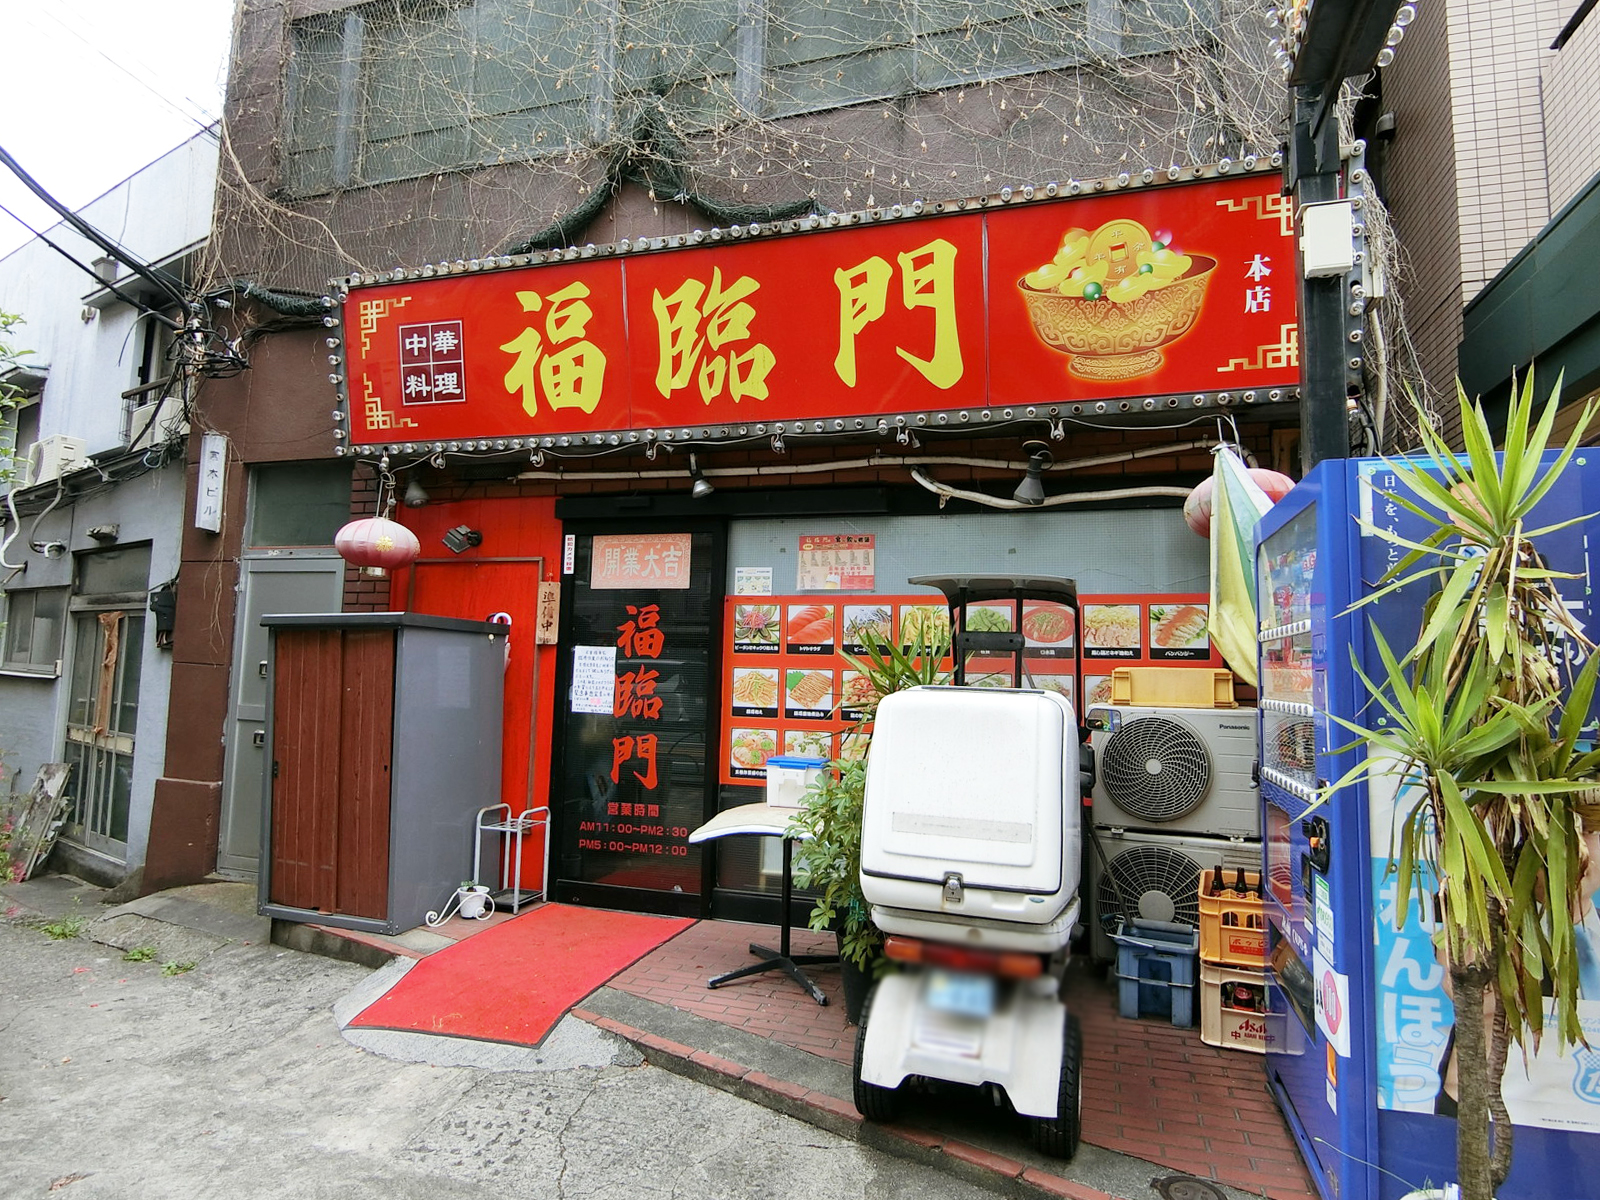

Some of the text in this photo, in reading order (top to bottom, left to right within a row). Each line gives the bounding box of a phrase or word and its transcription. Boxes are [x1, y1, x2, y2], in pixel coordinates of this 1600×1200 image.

[1243, 253, 1272, 314] 本店
[499, 238, 964, 417] 福臨門
[404, 330, 459, 356] 中華
[405, 371, 462, 398] 料理
[602, 545, 683, 578] 開業大吉
[610, 604, 665, 790] 福臨門
[1219, 723, 1251, 731] Panasonic
[607, 802, 660, 817] 営業時間
[1231, 1030, 1241, 1040] 中
